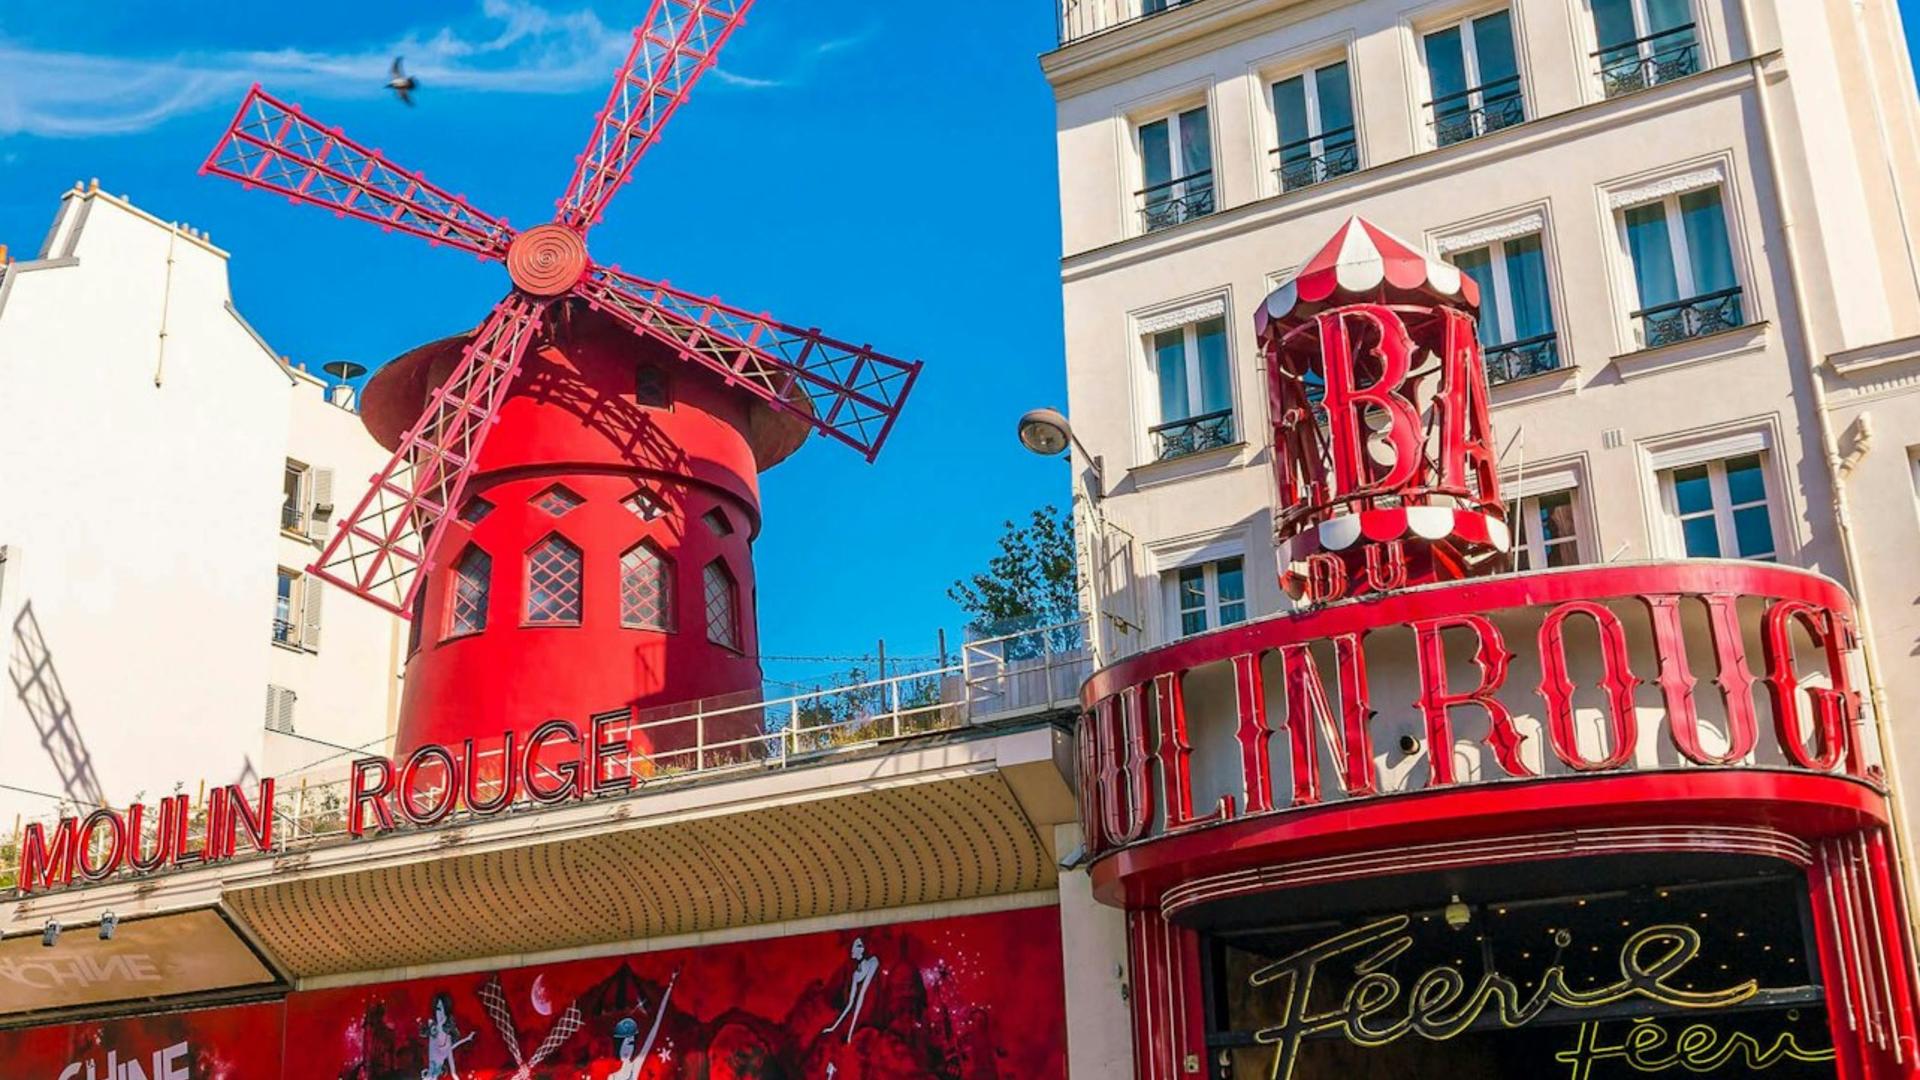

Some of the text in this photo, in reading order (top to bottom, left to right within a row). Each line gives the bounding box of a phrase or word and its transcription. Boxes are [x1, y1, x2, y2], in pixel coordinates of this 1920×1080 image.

[1306, 540, 1406, 602] DU
[18, 707, 638, 894] MOULIN ROUGE
[1250, 915, 1759, 1080] Féerie
